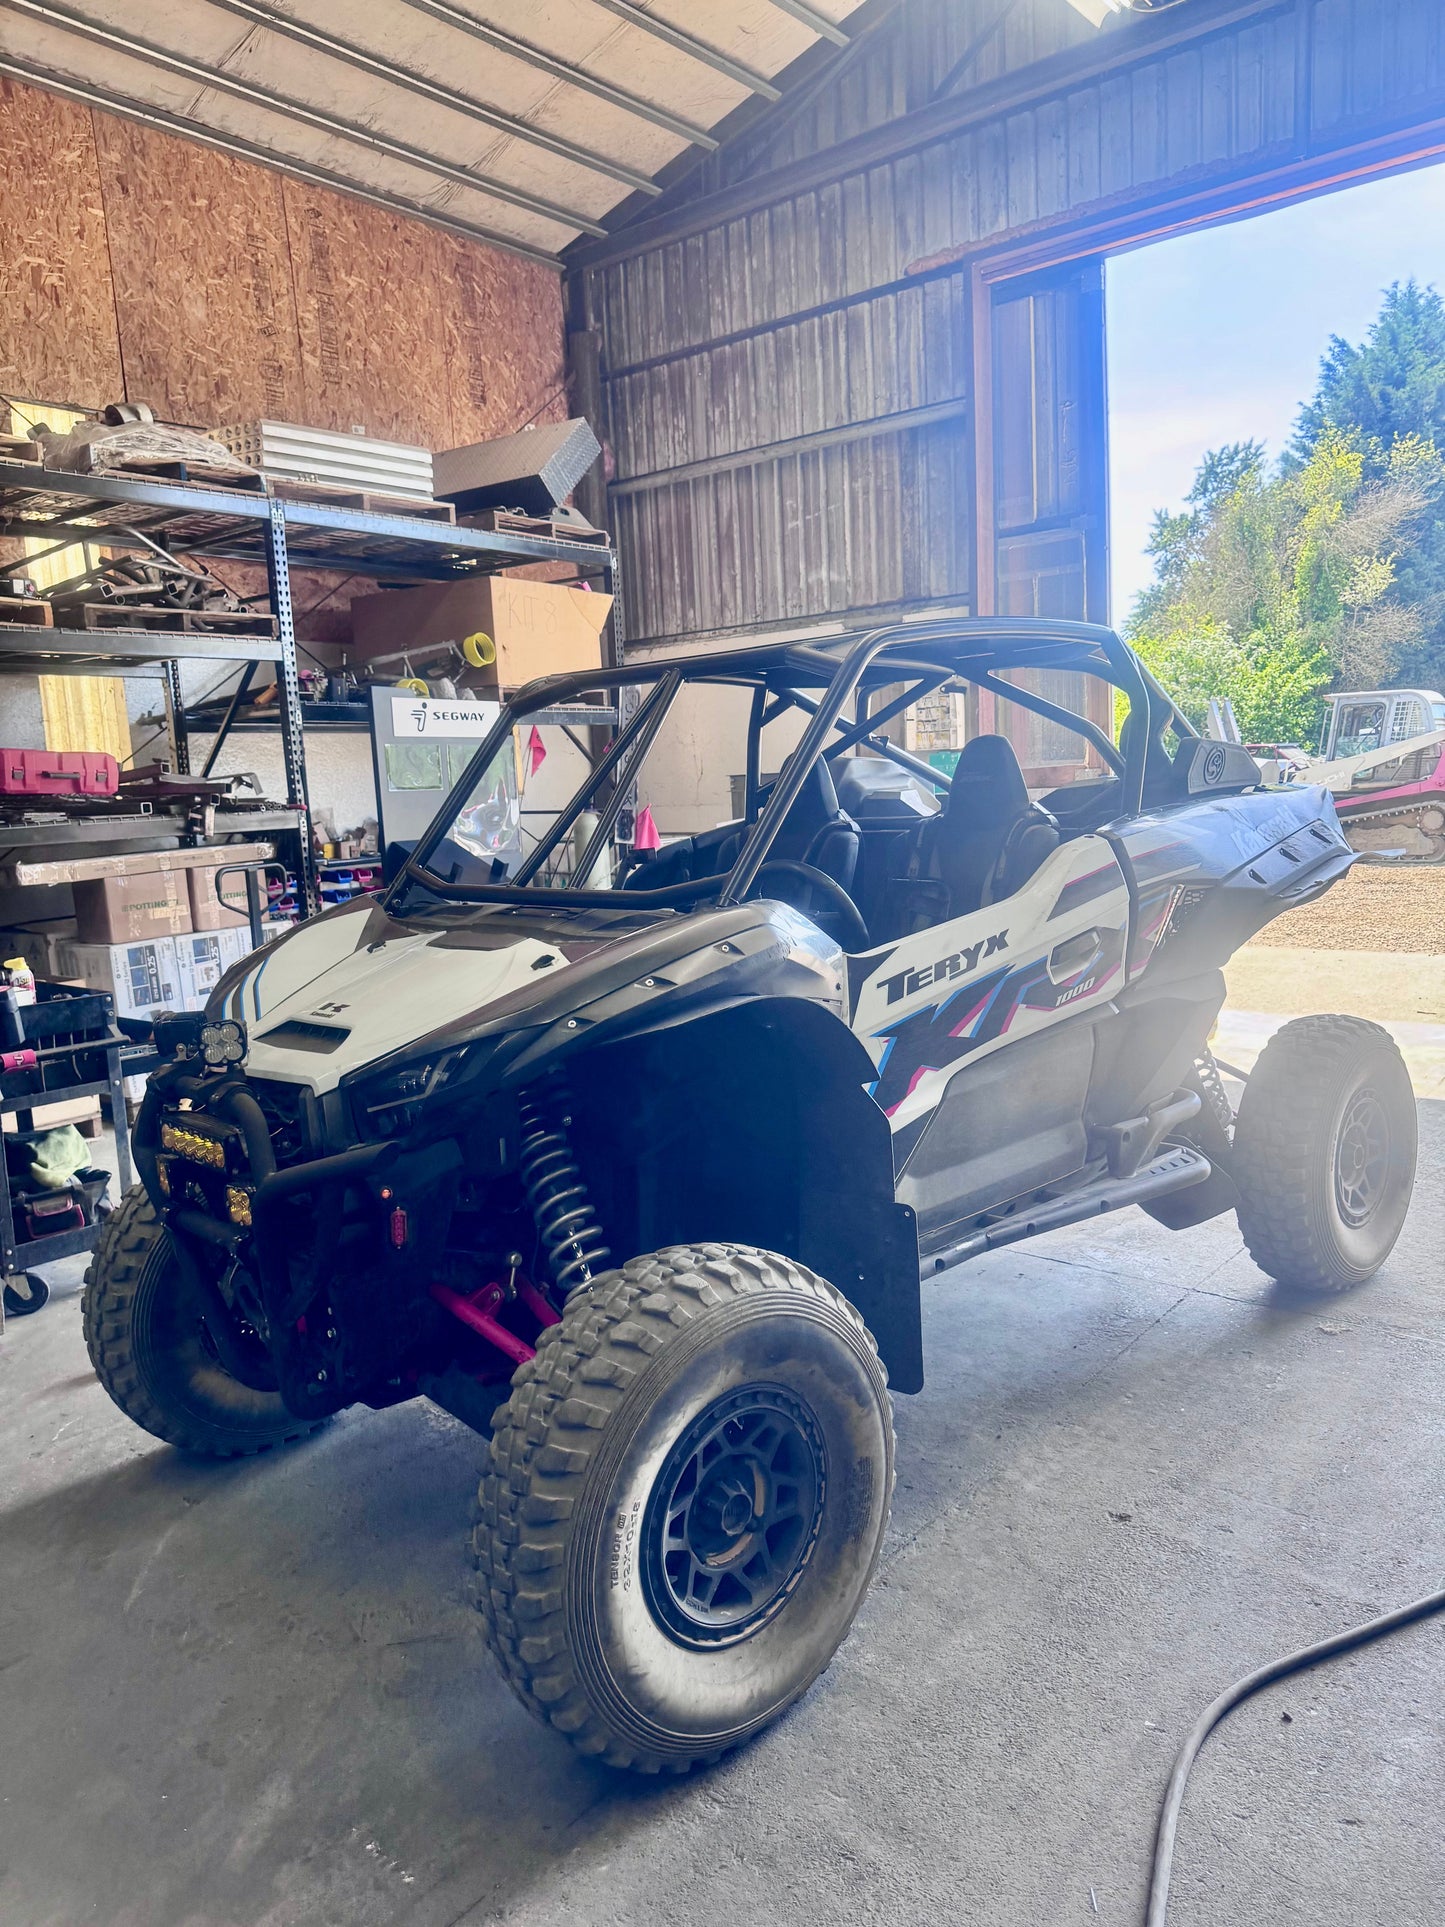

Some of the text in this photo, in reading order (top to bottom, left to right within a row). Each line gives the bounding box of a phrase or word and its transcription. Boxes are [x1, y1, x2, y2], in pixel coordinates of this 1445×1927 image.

[508, 592, 559, 635] KIT 8
[433, 711, 485, 722] SEGWAY
[148, 955, 157, 974] 0.25
[876, 929, 1010, 1006] TERYX
[1055, 976, 1096, 1008] 1000
[610, 1533, 623, 1590] TENSOR
